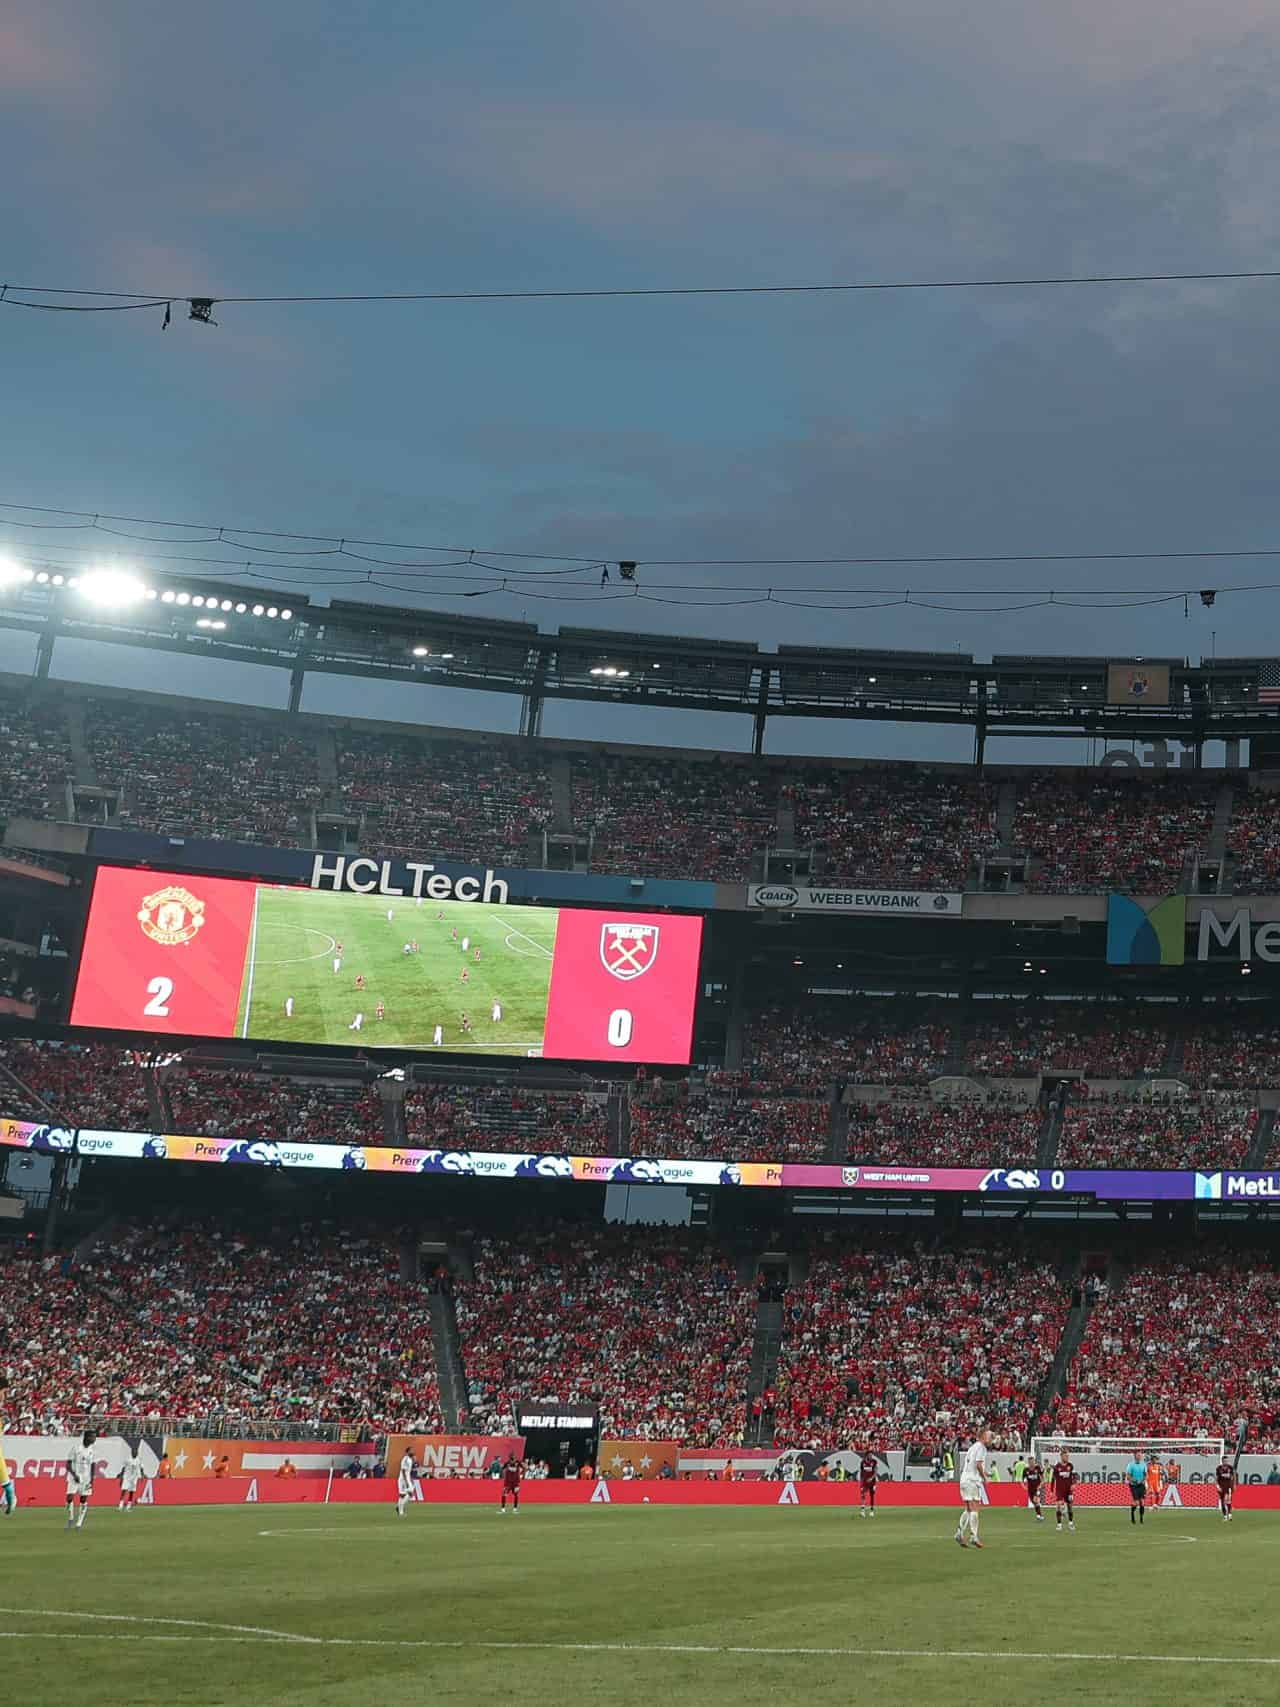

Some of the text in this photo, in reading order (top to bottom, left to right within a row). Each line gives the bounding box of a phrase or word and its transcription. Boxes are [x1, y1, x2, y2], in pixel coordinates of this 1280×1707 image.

[310, 854, 509, 904] HCLTech
[759, 891, 794, 901] COACH
[809, 892, 921, 907] WEEB EWBANK
[143, 976, 174, 1016] 2
[607, 1008, 633, 1047] 0
[474, 1160, 507, 1173] ague
[1051, 1171, 1065, 1190] 0
[423, 1444, 488, 1468] NEW
